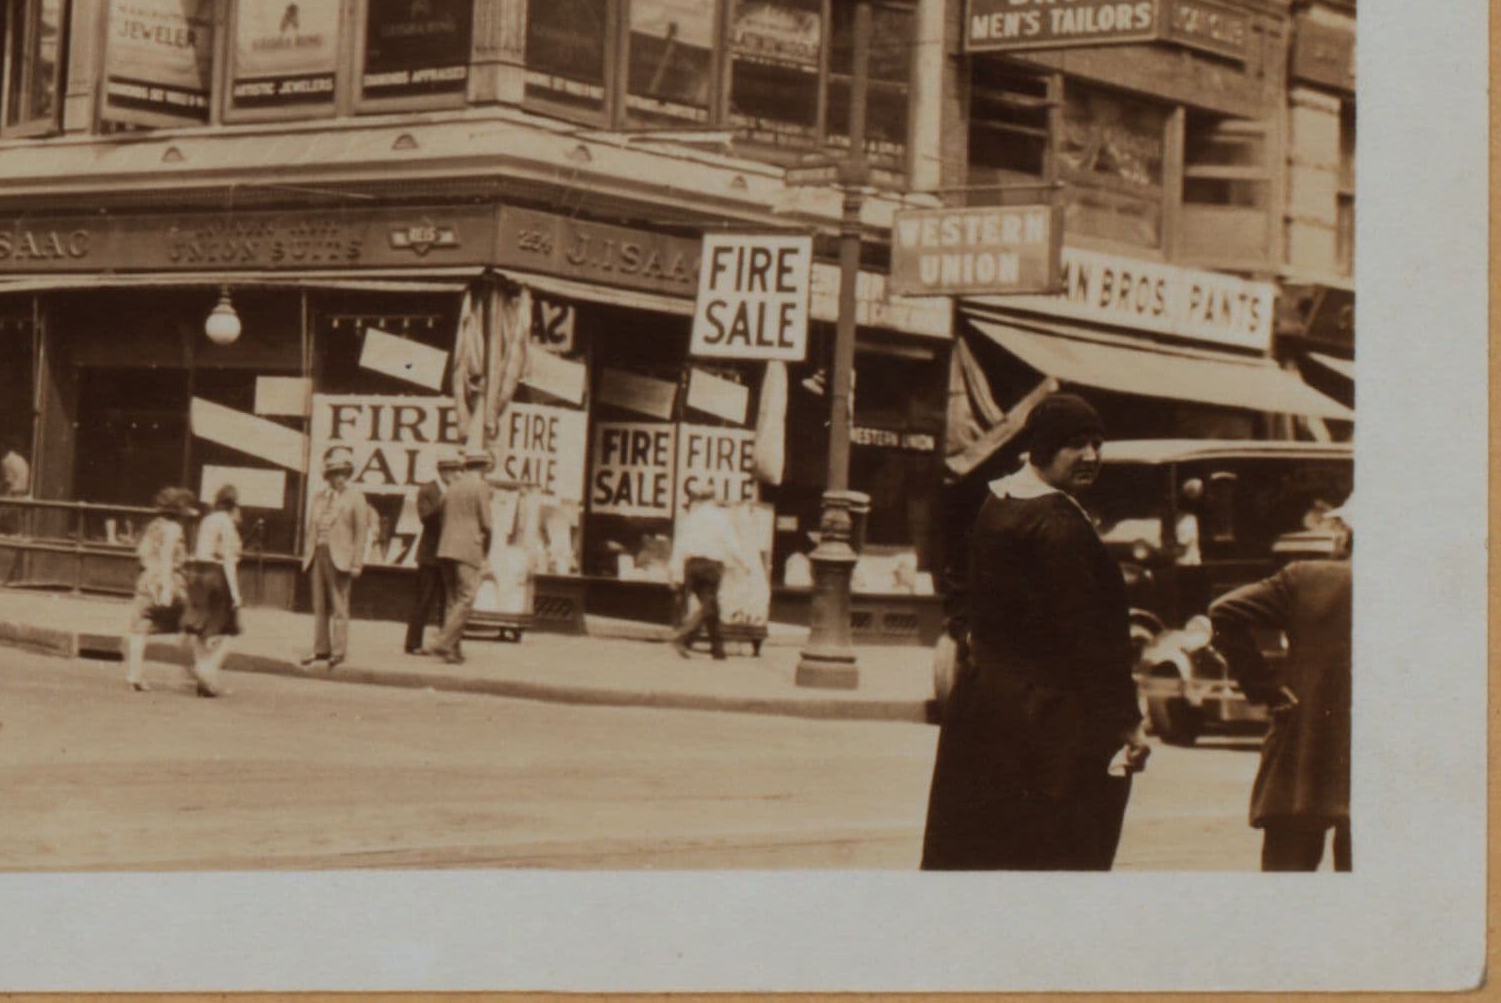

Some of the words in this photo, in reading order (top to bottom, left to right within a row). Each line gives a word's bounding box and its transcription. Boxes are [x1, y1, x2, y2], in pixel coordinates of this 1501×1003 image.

[118, 20, 197, 51] JEWELER
[971, 9, 1041, 40] MEN'S
[1049, 2, 1153, 35] TAILORS
[900, 214, 1047, 246] WESTERN
[269, 238, 363, 263] SUITS
[709, 245, 800, 294] FIRE
[919, 252, 1020, 284] UNION
[703, 299, 797, 348] SALE
[1190, 284, 1263, 333] PANTS
[327, 403, 468, 445] FIRE
[508, 411, 560, 454] FIRE
[601, 427, 671, 467] FIRE
[686, 433, 756, 474] FIRE
[504, 455, 556, 496] SALE
[594, 470, 668, 510] SALE
